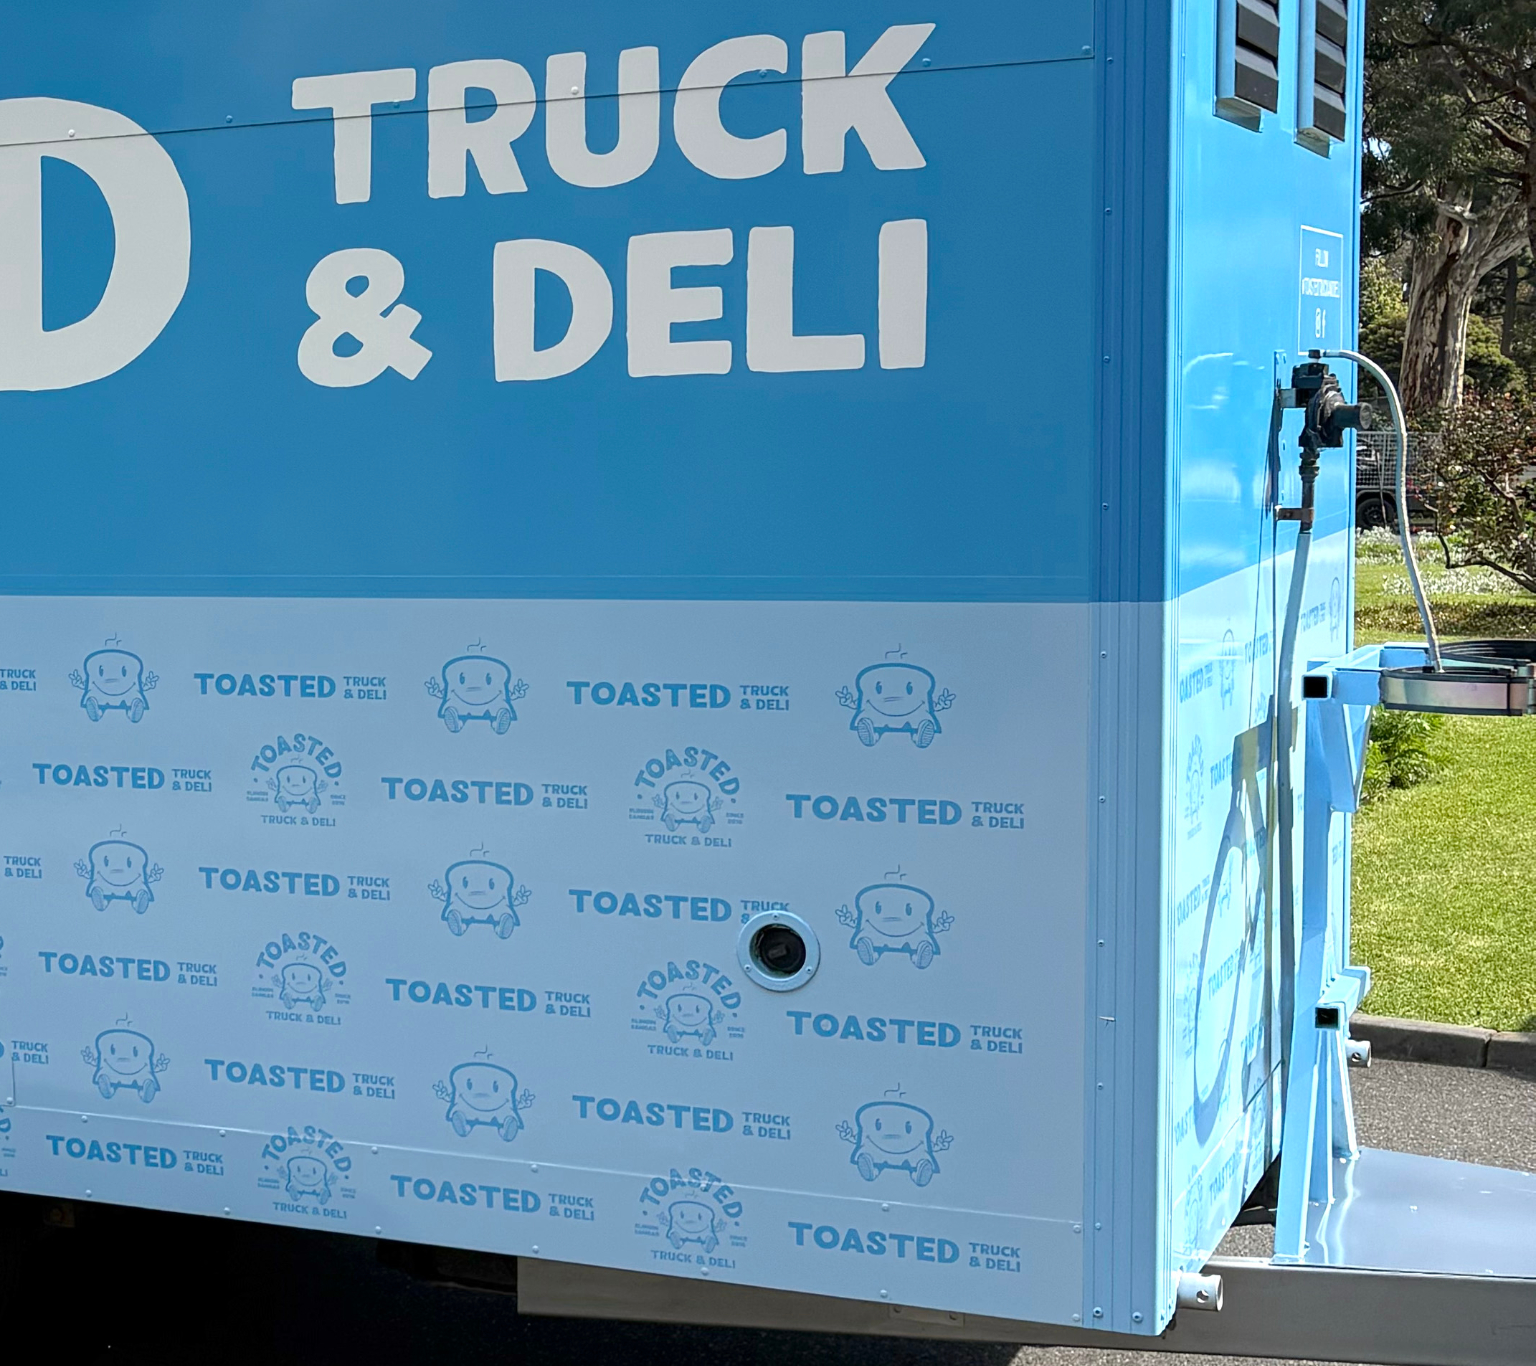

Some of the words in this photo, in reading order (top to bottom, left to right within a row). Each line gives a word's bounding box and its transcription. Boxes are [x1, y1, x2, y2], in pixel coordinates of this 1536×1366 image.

[292, 23, 936, 205] TRUCK
[298, 248, 433, 388] &
[493, 219, 928, 382] DELI
[0, 668, 35, 679] TRUCK
[0, 680, 8, 690] &
[11, 680, 36, 691] DELI
[194, 673, 336, 698] TOASTED
[343, 676, 386, 688] TRUCK
[344, 689, 353, 700] &
[358, 689, 386, 701] DELI
[567, 681, 731, 708] TOASTED
[740, 684, 789, 698] TRUCK
[740, 698, 751, 710] &
[756, 698, 789, 711] DELI
[251, 733, 341, 779] TOASTED
[33, 763, 164, 789] TOASTED
[172, 768, 211, 780] TRUCK
[635, 746, 739, 795] TOASTED
[172, 780, 181, 791] &
[185, 780, 212, 792] DELI
[381, 777, 533, 805] TOASTED
[542, 783, 587, 796] TRUCK
[542, 796, 552, 808] &
[557, 796, 587, 809] DELI
[786, 794, 961, 825] TOASTED
[971, 802, 1024, 816] TRUCK
[261, 815, 296, 825] TRUCK
[312, 817, 335, 827] DELI
[972, 815, 983, 828] &
[989, 816, 1024, 830] DELI
[645, 834, 686, 844] TRUCK
[705, 836, 731, 847] DELI
[4, 855, 41, 868] TRUCK
[5, 867, 13, 878] &
[16, 867, 42, 880] DELI
[199, 867, 340, 896] TOASTED
[347, 875, 389, 889] TRUCK
[348, 887, 357, 899] &
[361, 888, 390, 901] DELI
[569, 889, 731, 921] TOASTED
[256, 932, 346, 977] TOASTED
[39, 952, 170, 981] TOASTED
[177, 961, 216, 975] TRUCK
[178, 973, 186, 984] &
[191, 974, 217, 987] DELI
[637, 960, 740, 1009] TOASTED
[386, 979, 536, 1012] TOASTED
[545, 991, 590, 1006] TRUCK
[266, 1011, 302, 1022] TRUCK
[317, 1015, 341, 1025] DELI
[545, 1003, 556, 1016] &
[560, 1004, 590, 1019] DELI
[787, 1011, 960, 1047] TOASTED
[970, 1025, 1022, 1041] TRUCK
[11, 1040, 48, 1054] TRUCK
[647, 1044, 688, 1056] TRUCK
[706, 1049, 733, 1060] DELI
[970, 1039, 982, 1052] &
[987, 1040, 1022, 1055] DELI
[11, 1052, 20, 1063] &
[24, 1053, 48, 1066] DELI
[205, 1059, 345, 1093] TOASTED
[353, 1072, 394, 1087] TRUCK
[353, 1085, 362, 1097] &
[367, 1086, 395, 1100] DELI
[572, 1095, 733, 1133] TOASTED
[742, 1111, 790, 1128] TRUCK
[742, 1124, 753, 1137] &
[758, 1126, 791, 1141] DELI
[46, 1135, 177, 1169] TOASTED
[262, 1126, 351, 1171] TOASTED
[183, 1150, 222, 1165] TRUCK
[184, 1162, 193, 1173] &
[197, 1163, 224, 1177] DELI
[390, 1175, 540, 1212] TOASTED
[548, 1192, 593, 1209] TRUCK
[640, 1168, 742, 1218] TOASTED
[273, 1202, 308, 1214] TRUCK
[323, 1208, 347, 1219] DELI
[549, 1205, 560, 1218] &
[564, 1207, 594, 1222] DELI
[788, 1222, 959, 1263] TOASTED
[969, 1241, 1020, 1259] TRUCK
[651, 1250, 691, 1263] TRUCK
[709, 1257, 735, 1269] DELI
[969, 1255, 981, 1269] &
[986, 1257, 1020, 1273] DELI
